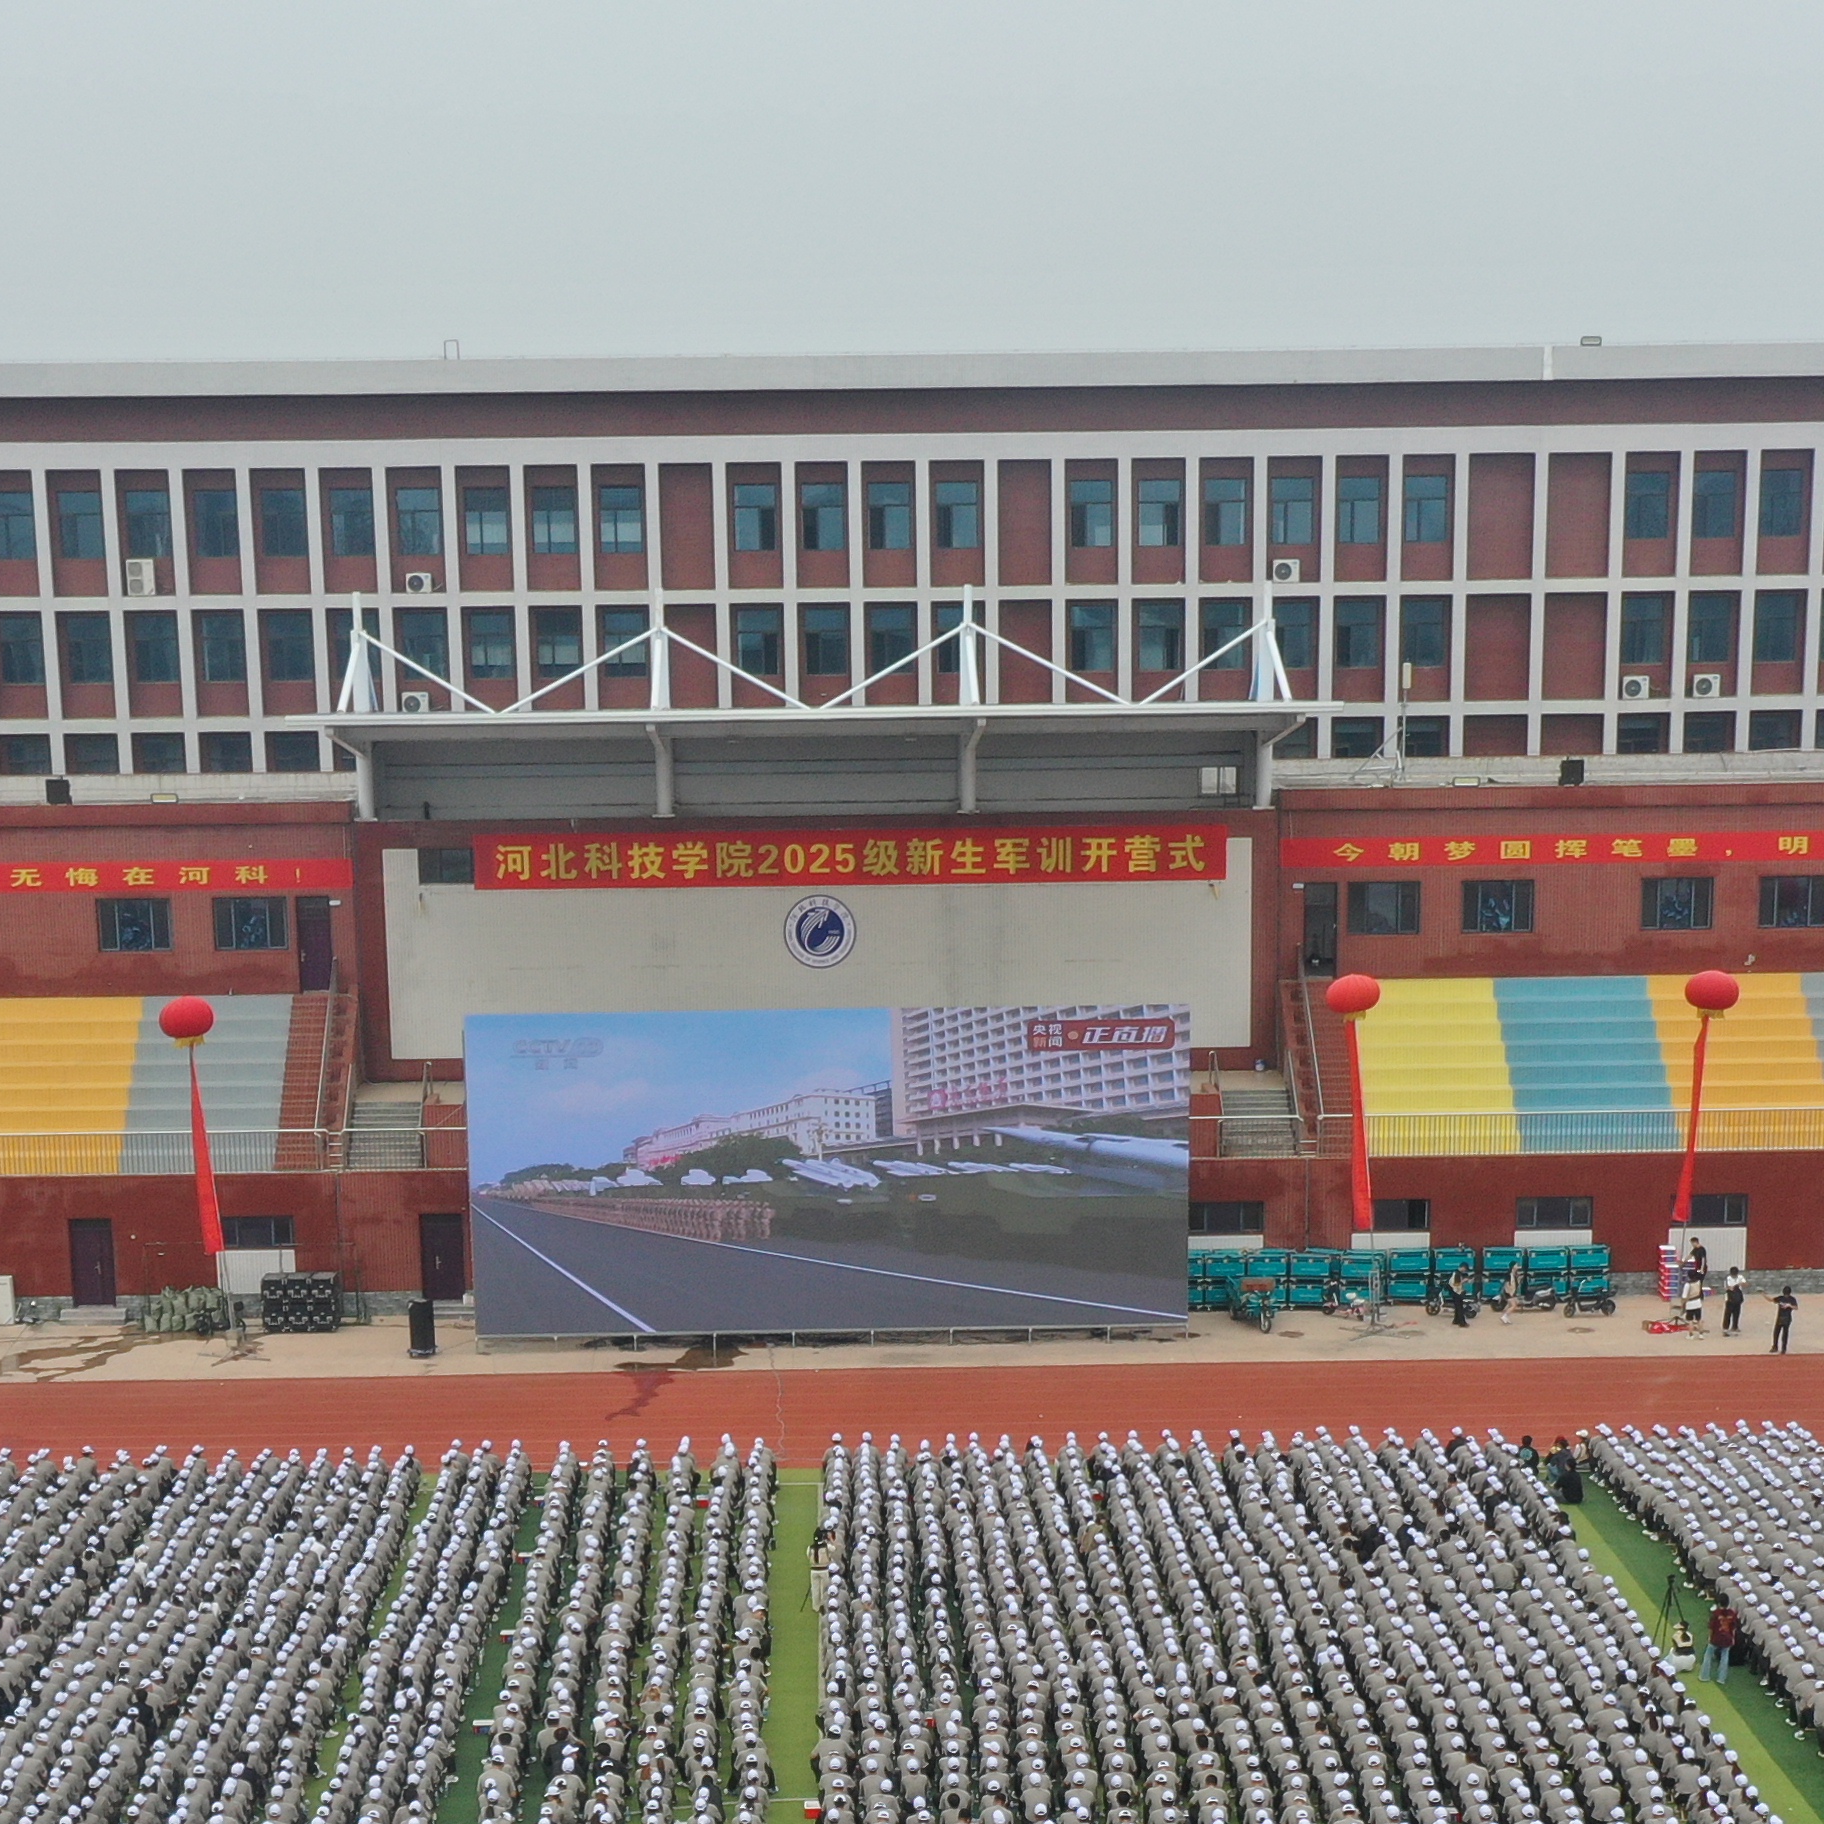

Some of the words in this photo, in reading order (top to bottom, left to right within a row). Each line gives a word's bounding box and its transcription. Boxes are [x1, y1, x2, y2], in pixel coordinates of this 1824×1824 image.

[495, 835, 1206, 881] 河北科技学院2025级新生军训开营式
